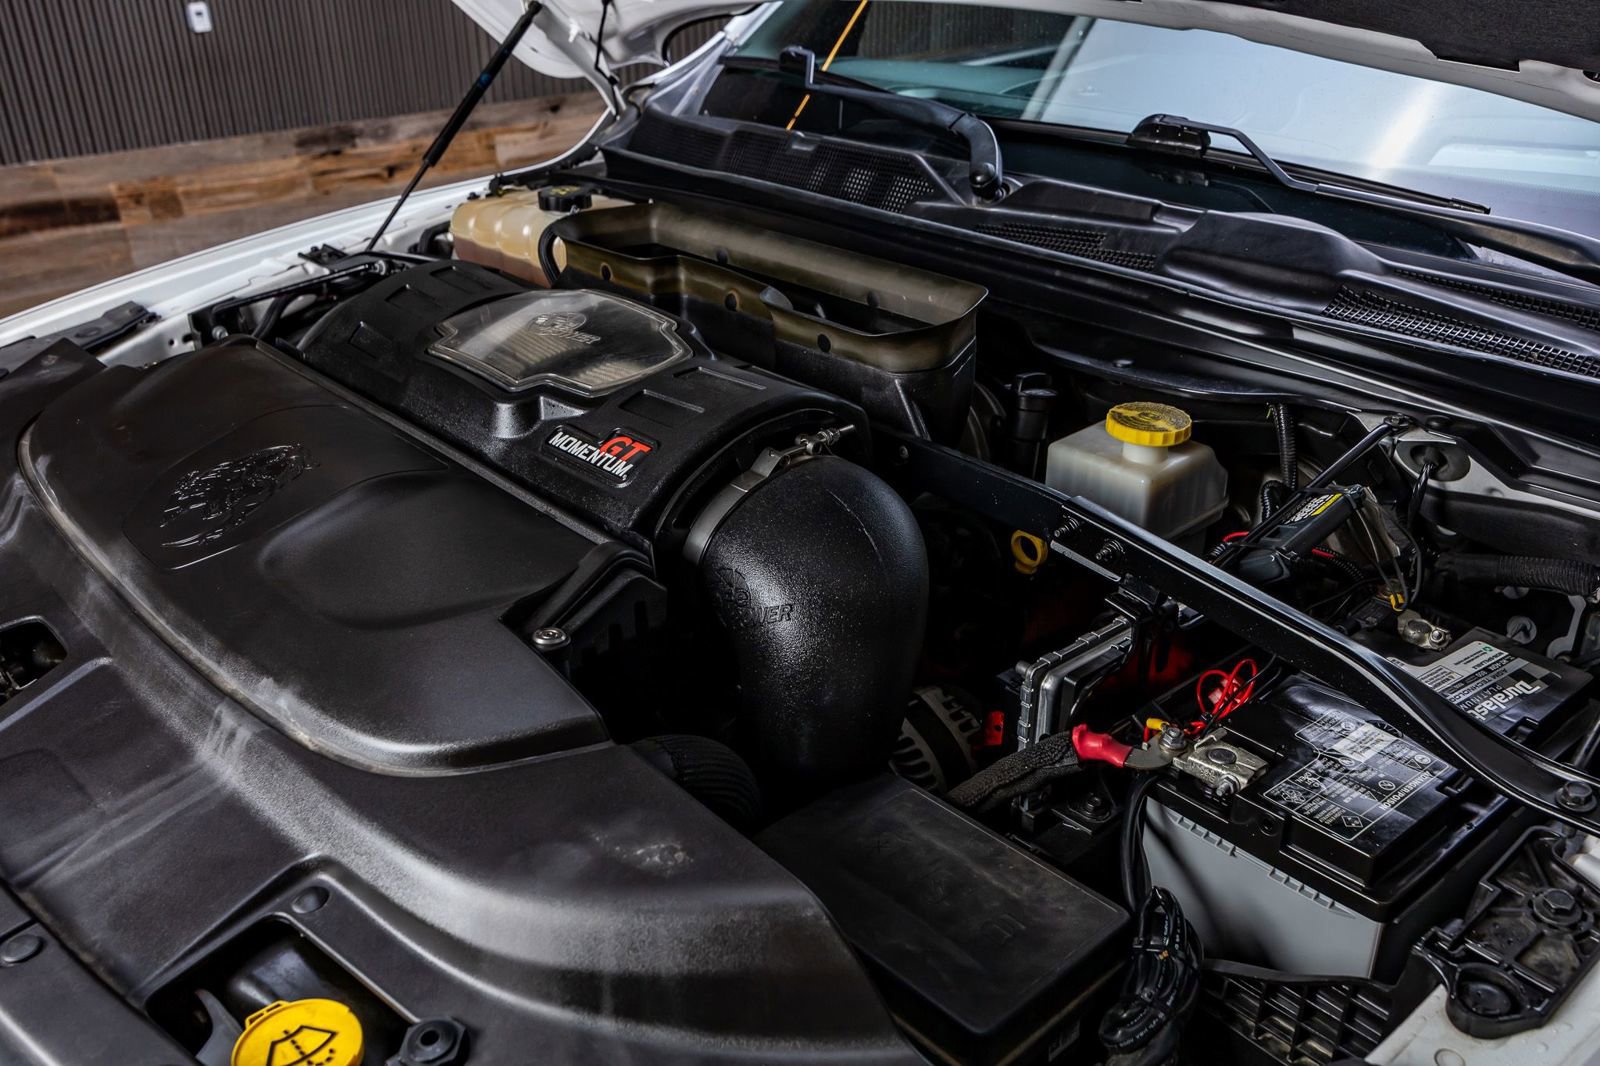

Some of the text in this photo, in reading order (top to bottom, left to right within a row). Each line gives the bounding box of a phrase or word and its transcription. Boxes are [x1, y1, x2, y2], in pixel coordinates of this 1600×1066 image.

[548, 431, 632, 478] MOMENTUM
[599, 436, 651, 462] GT
[1488, 667, 1509, 679] AGM
[1447, 677, 1492, 703] TECHNOLOG
[1457, 683, 1502, 710] PLATINUM
[1467, 680, 1540, 722] Duralast
